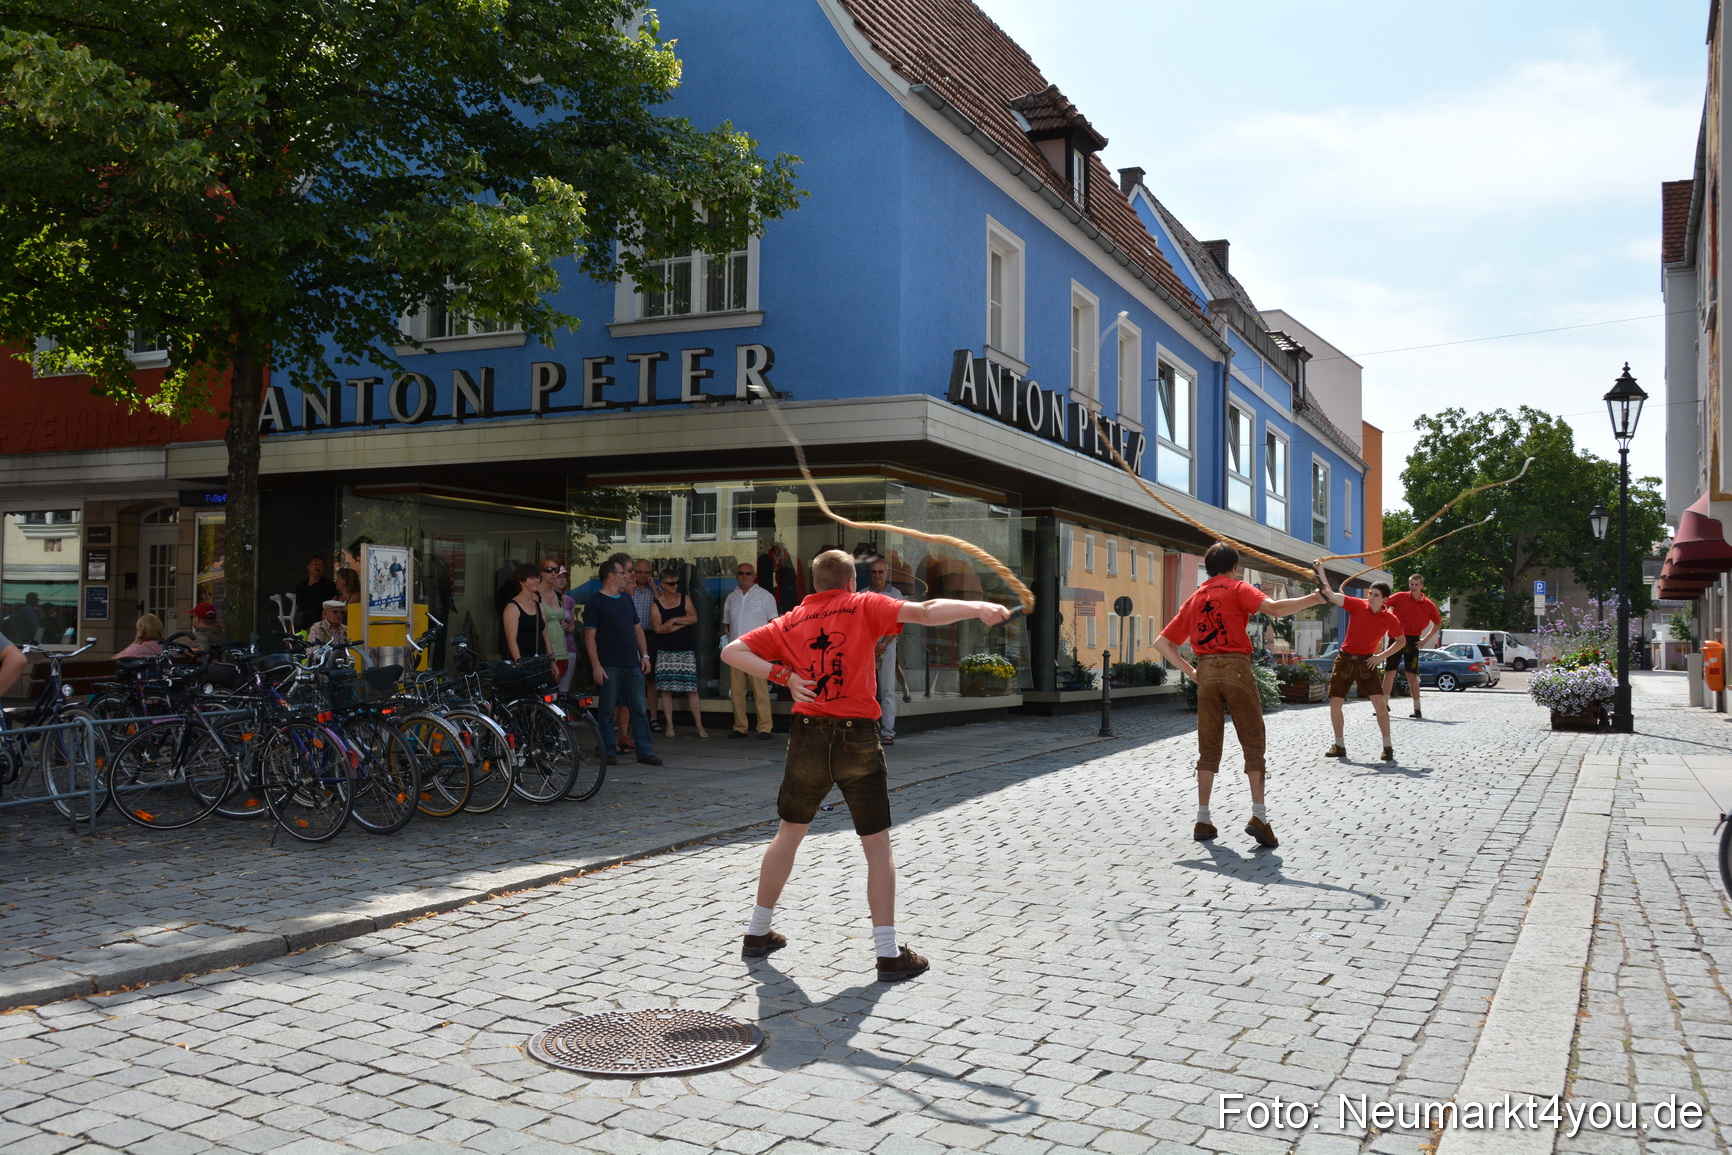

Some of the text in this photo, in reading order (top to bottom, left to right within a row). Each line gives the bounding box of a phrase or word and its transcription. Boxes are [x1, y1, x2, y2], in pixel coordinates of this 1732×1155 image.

[258, 344, 776, 432] ANTON PETER
[954, 349, 1147, 477] ANTON PETER
[205, 494, 227, 503] Fußpf
